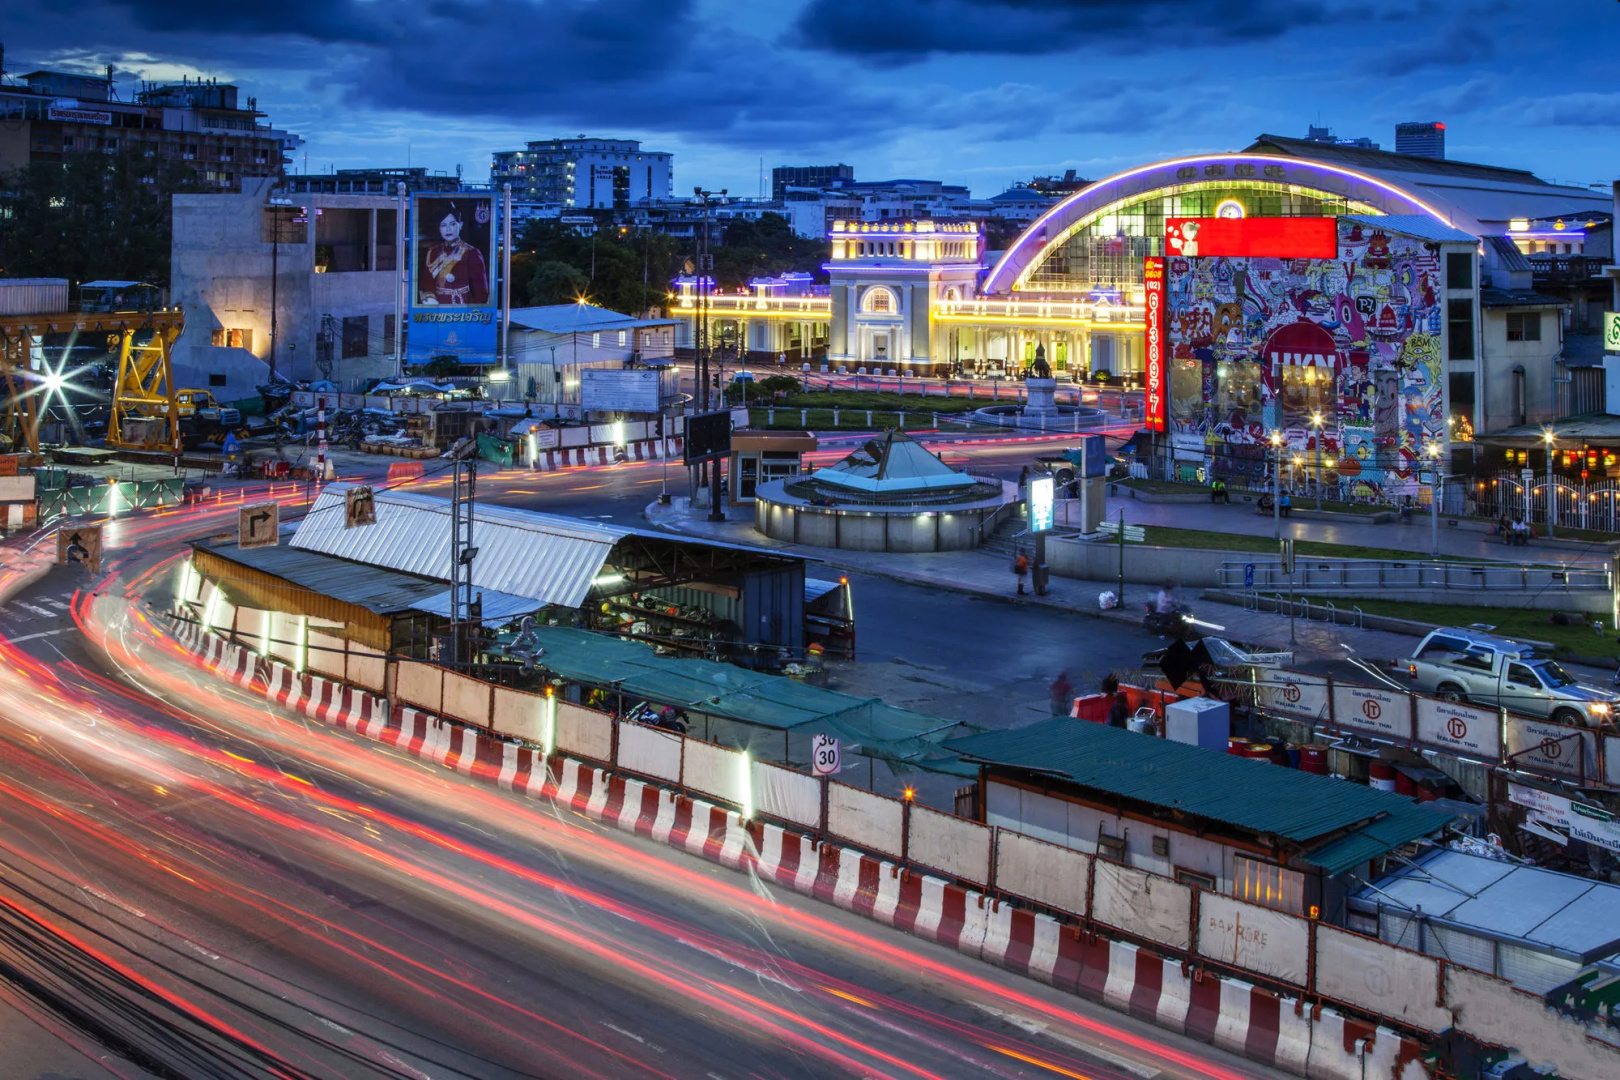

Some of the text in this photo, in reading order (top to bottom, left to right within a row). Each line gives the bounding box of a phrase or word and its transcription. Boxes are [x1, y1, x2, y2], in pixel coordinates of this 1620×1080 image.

[1146, 280, 1161, 291] (02)
[413, 309, 492, 324] ทรงพระเจริญ
[1436, 734, 1461, 745] ITALIAN
[1463, 741, 1478, 749] THAI
[819, 750, 836, 765] 30
